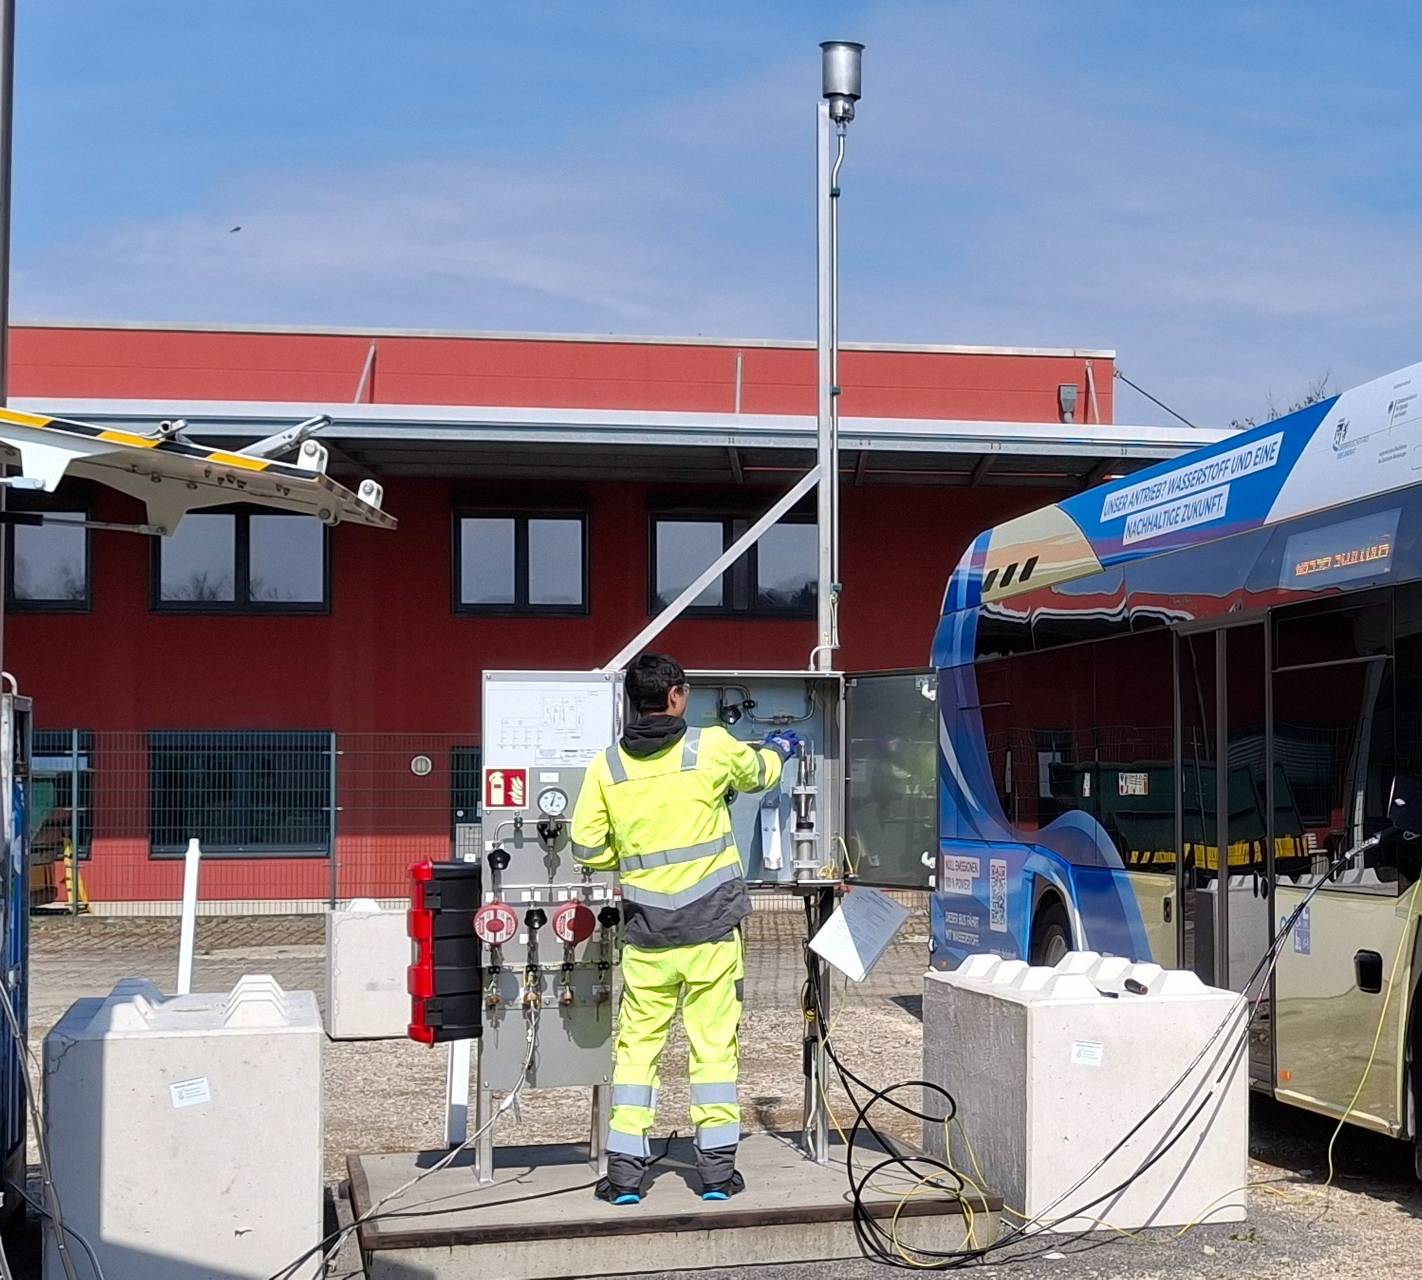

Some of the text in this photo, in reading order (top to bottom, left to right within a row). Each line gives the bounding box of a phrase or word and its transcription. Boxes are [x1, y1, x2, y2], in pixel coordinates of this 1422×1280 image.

[1103, 441, 1278, 517] UNSER ANTRIEB? WASSERSTOFF UND EINE
[1125, 493, 1223, 539] NACHHALTIGE ZUKUNFT.
